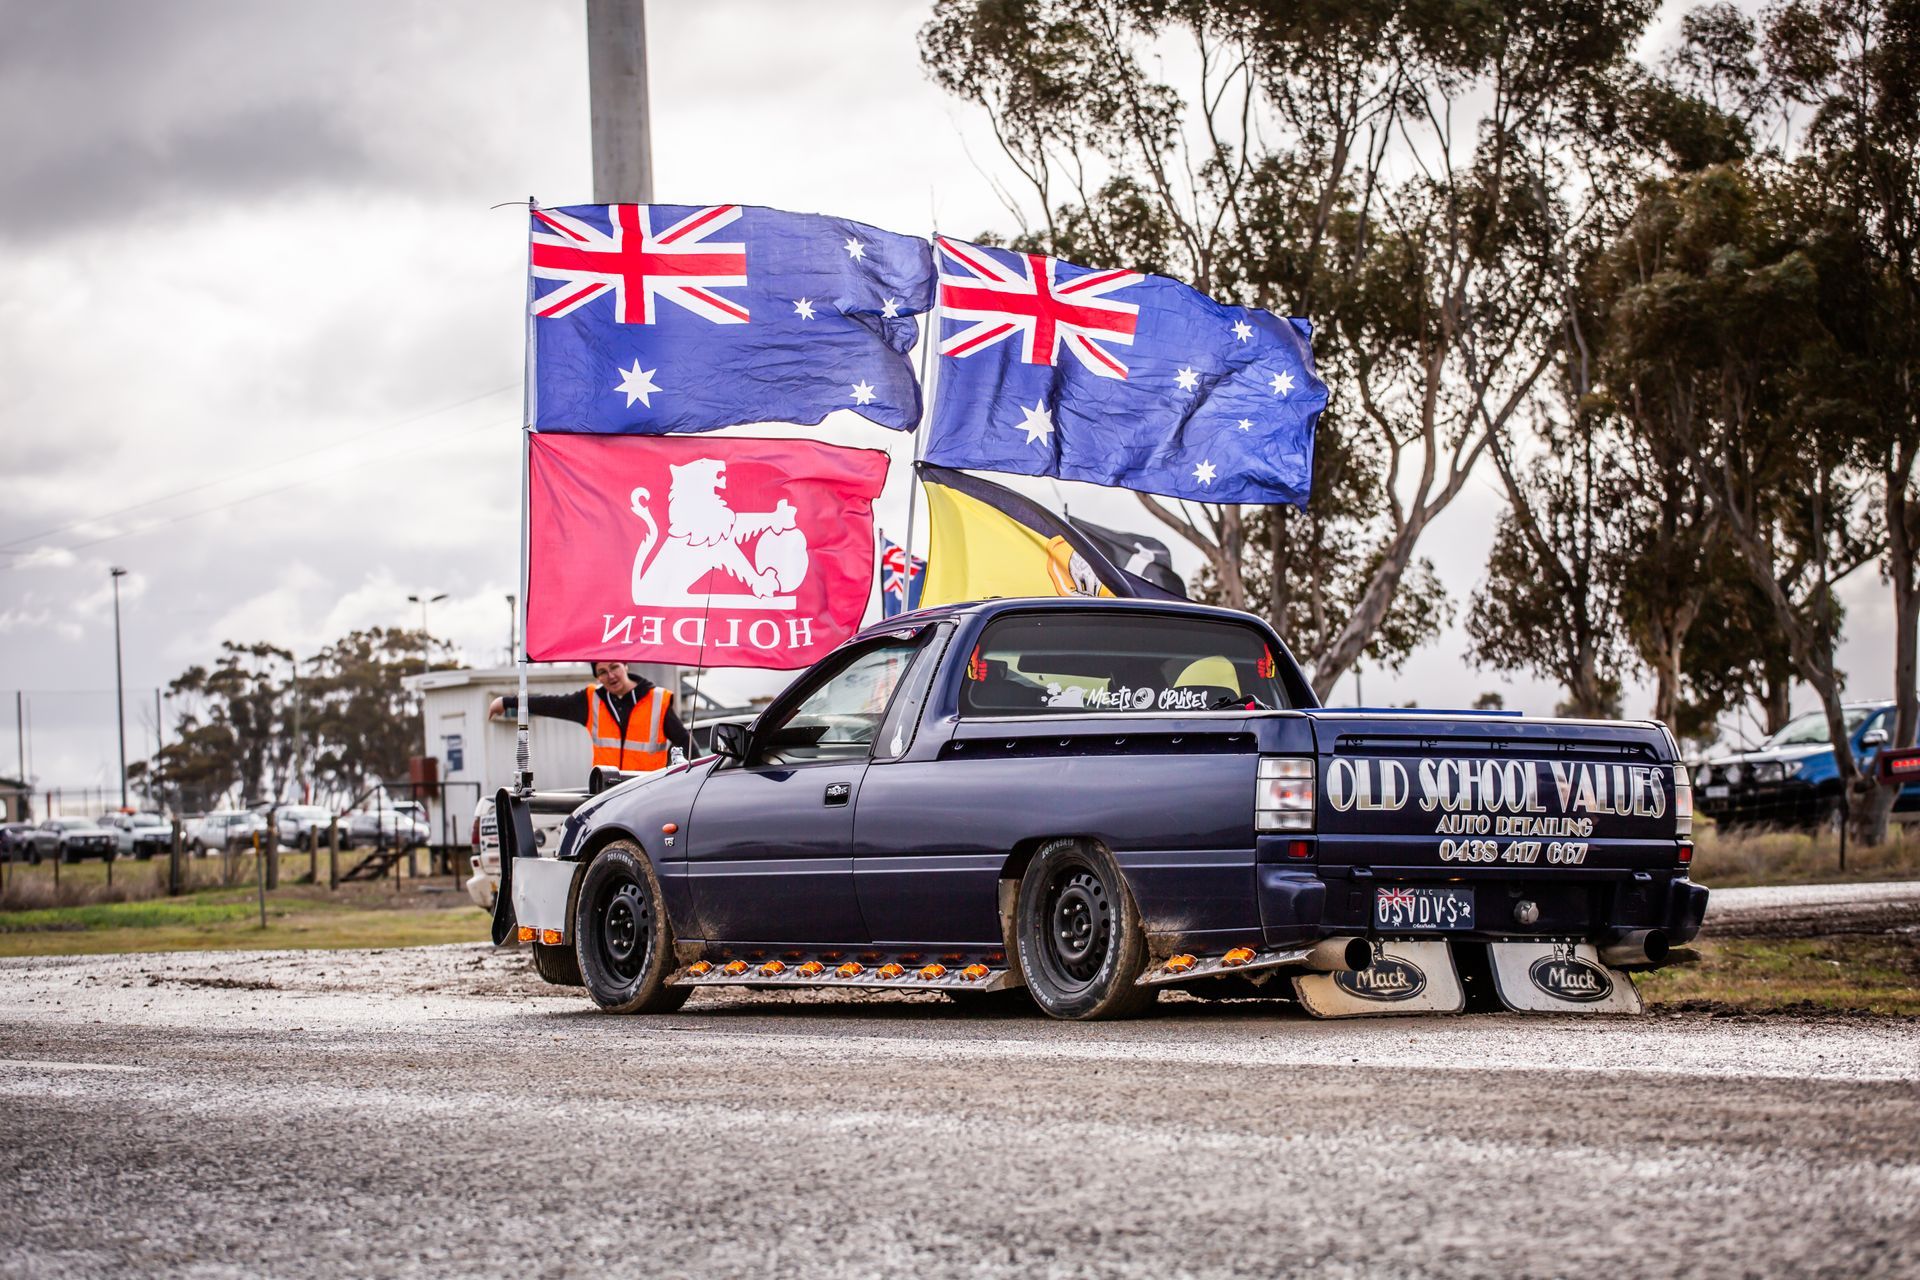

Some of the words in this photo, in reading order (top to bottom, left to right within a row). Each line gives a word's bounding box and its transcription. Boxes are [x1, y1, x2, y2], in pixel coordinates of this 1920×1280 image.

[1326, 757, 1410, 813] OLD
[1418, 757, 1547, 814] SCHOOL
[1549, 760, 1666, 819] VALUES
[1435, 814, 1490, 835] AUTO
[1495, 816, 1594, 837] DETAILING
[1438, 838, 1498, 862] 0438
[1500, 841, 1542, 864] 417
[1547, 842, 1589, 865] 667
[1378, 897, 1457, 923] OSVDVS
[1356, 966, 1413, 991] Mack
[1548, 967, 1600, 992] Mack
